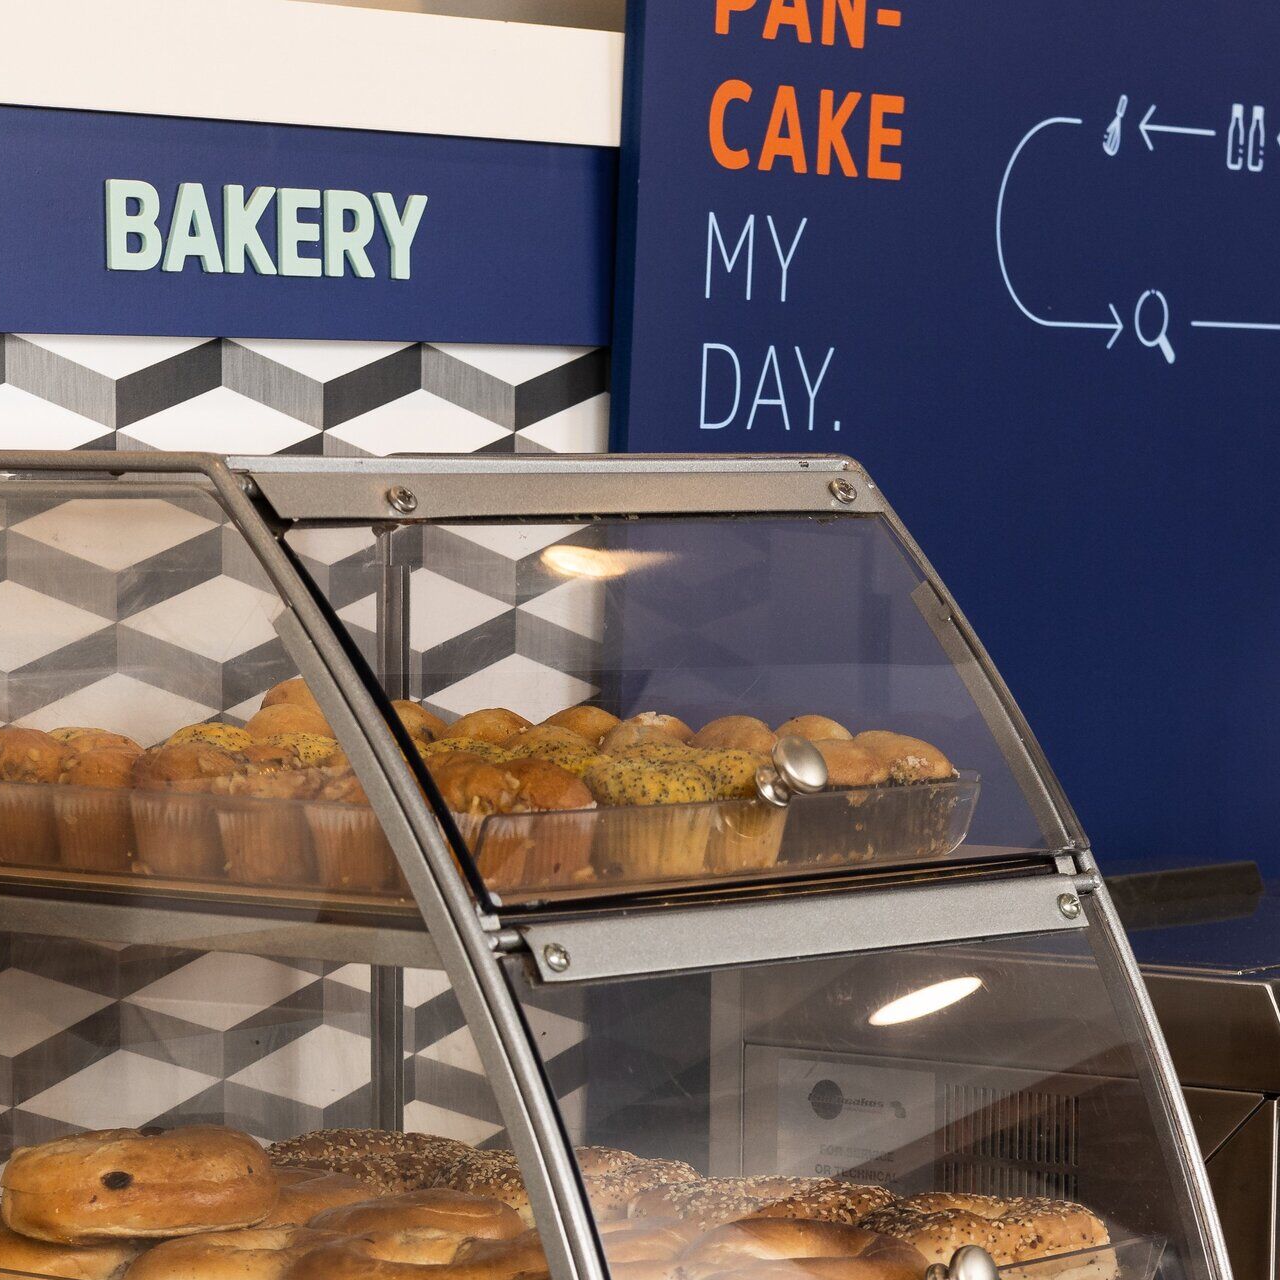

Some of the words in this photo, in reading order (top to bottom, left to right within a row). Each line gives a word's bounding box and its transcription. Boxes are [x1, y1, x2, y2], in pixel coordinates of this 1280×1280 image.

[708, 78, 905, 181] CAKE
[104, 178, 429, 281] BAKERY
[705, 211, 808, 303] MY
[698, 342, 842, 433] DAY.
